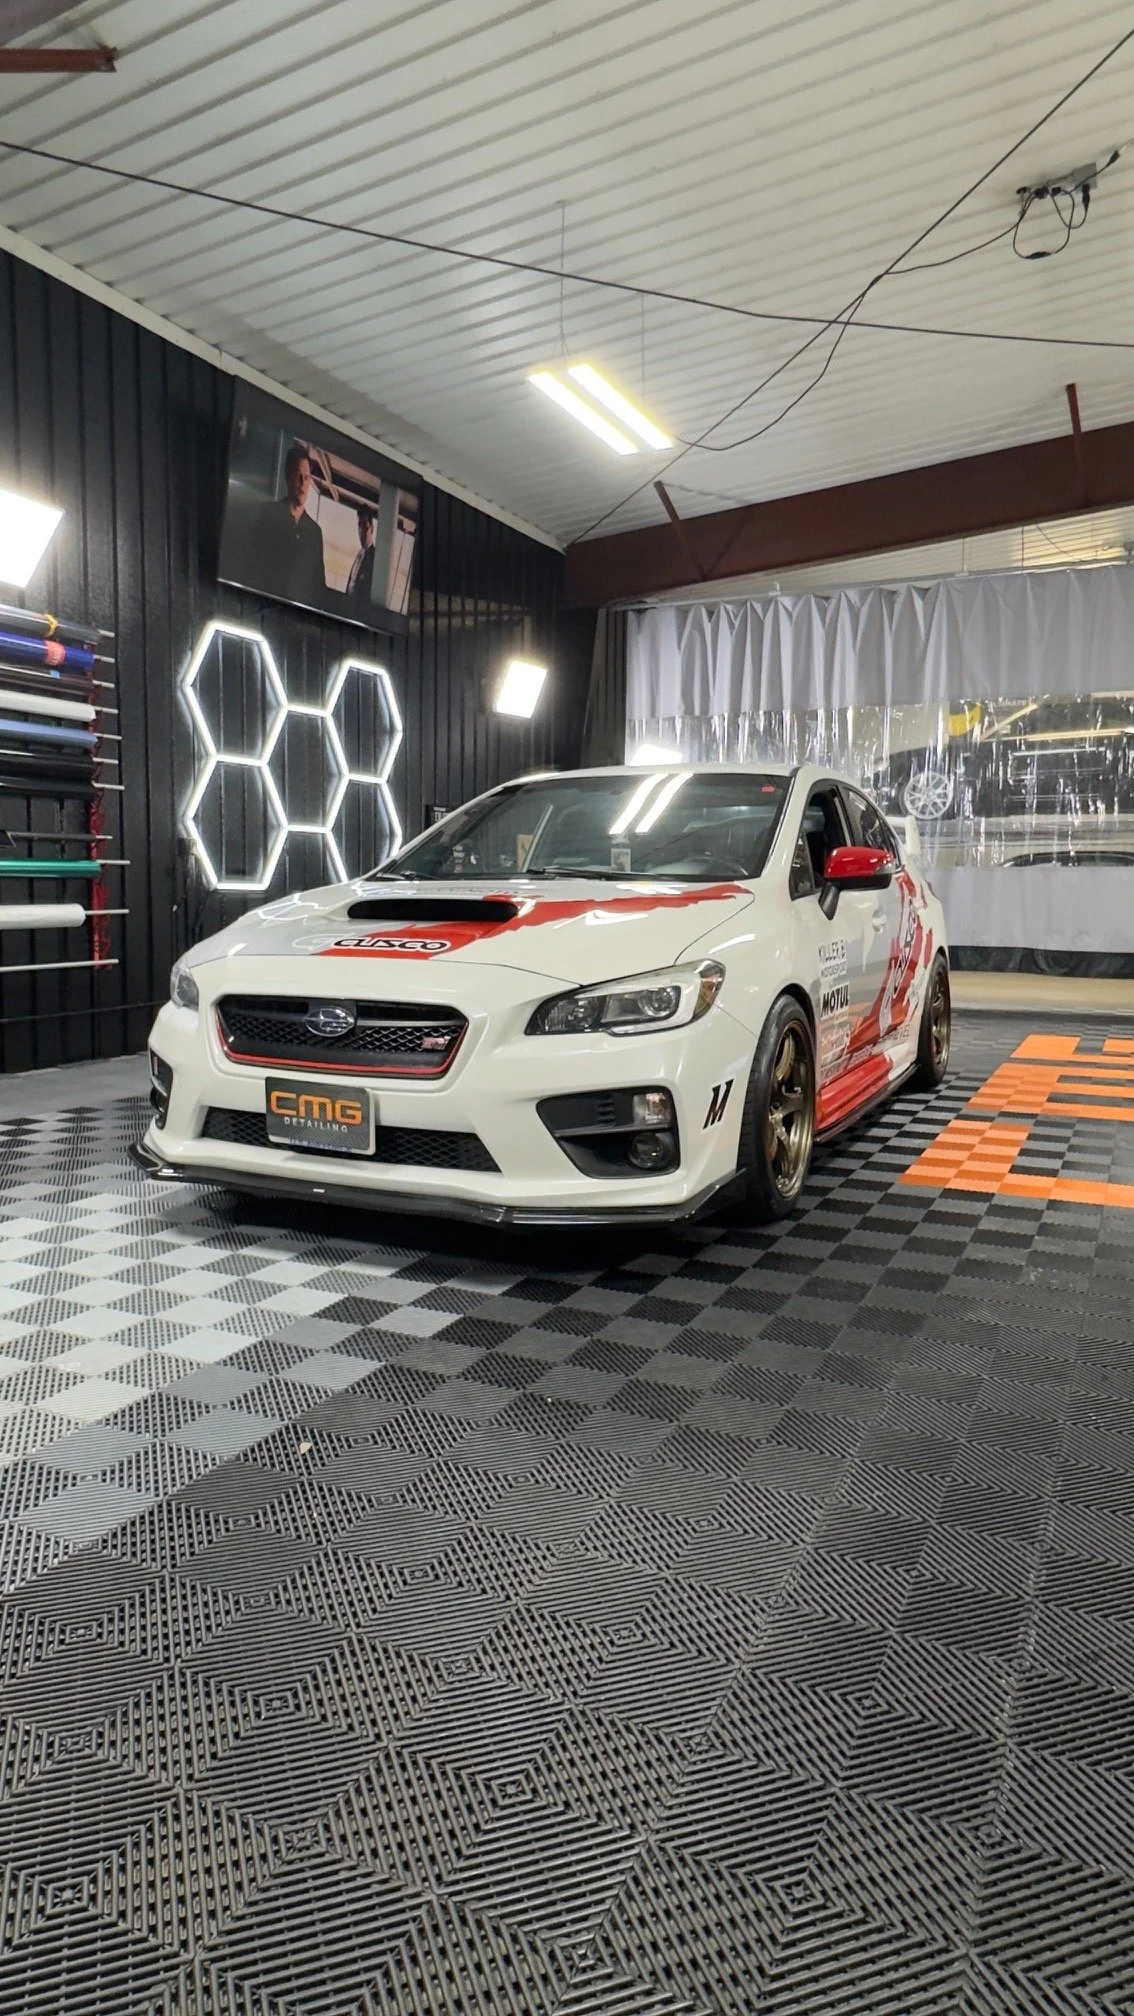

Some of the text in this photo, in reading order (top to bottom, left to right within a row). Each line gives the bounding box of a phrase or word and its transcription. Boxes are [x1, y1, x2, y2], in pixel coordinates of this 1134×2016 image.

[333, 937, 449, 951] CUSCO
[821, 984, 849, 1018] MOTUL
[270, 1090, 363, 1125] CMG
[284, 1116, 348, 1133] DETAILING
